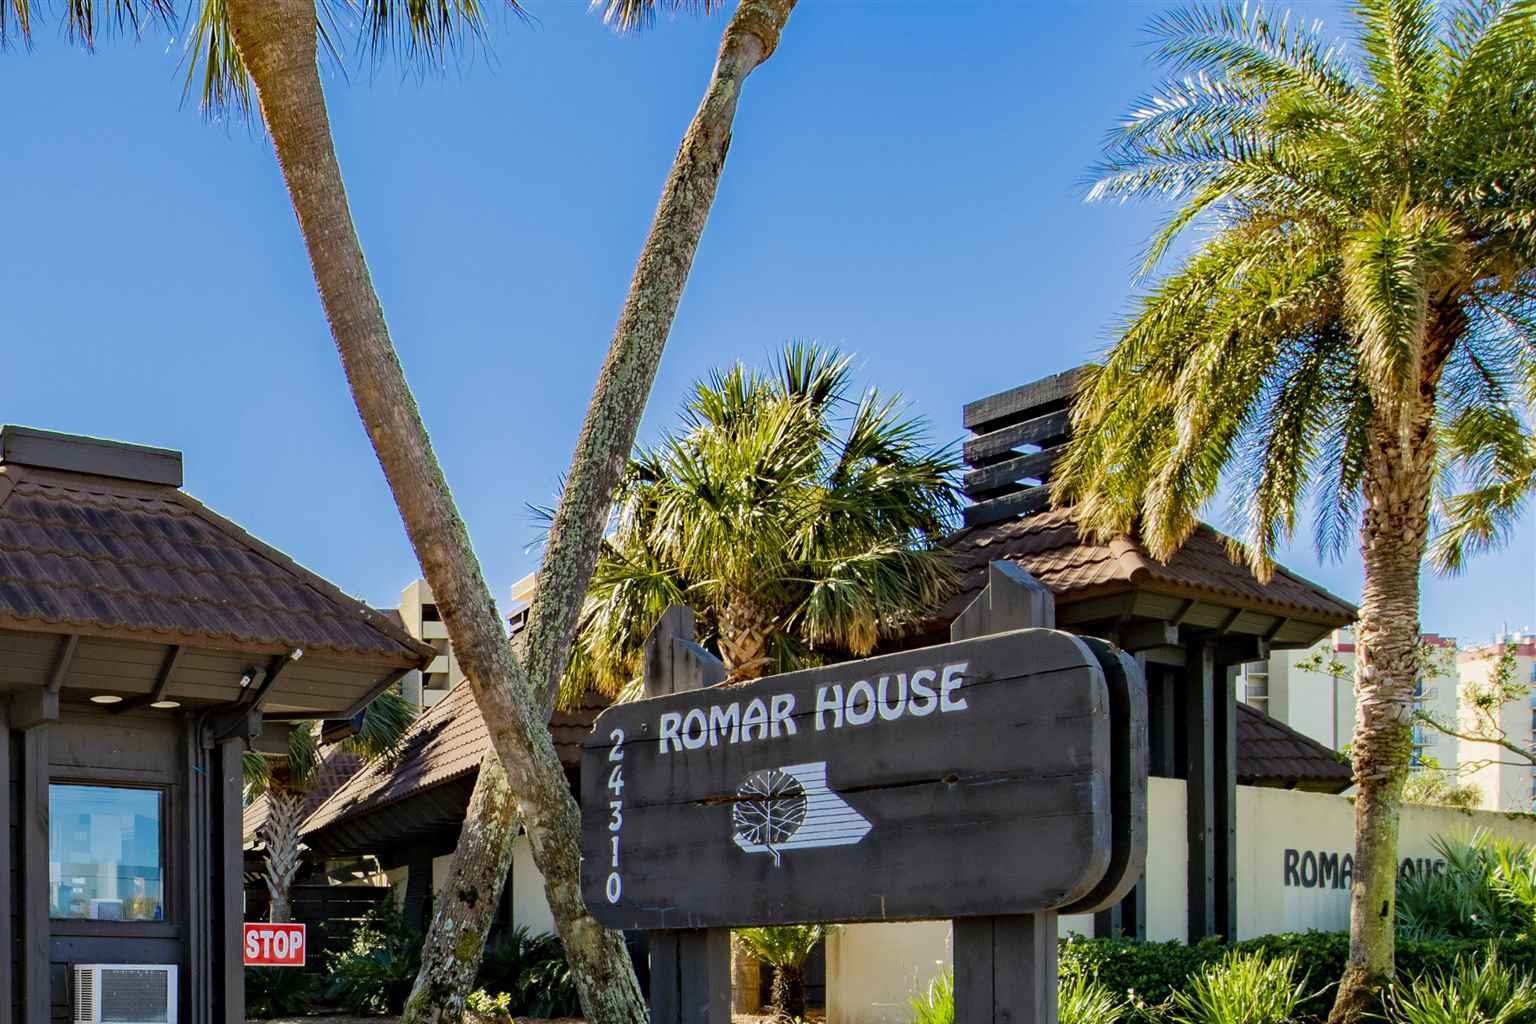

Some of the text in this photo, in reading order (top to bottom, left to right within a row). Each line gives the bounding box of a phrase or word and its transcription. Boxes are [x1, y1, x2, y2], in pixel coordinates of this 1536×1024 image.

[659, 662, 969, 754] ROMAR HOUSE
[1284, 848, 1354, 890] ROMA
[246, 930, 303, 959] STOP
